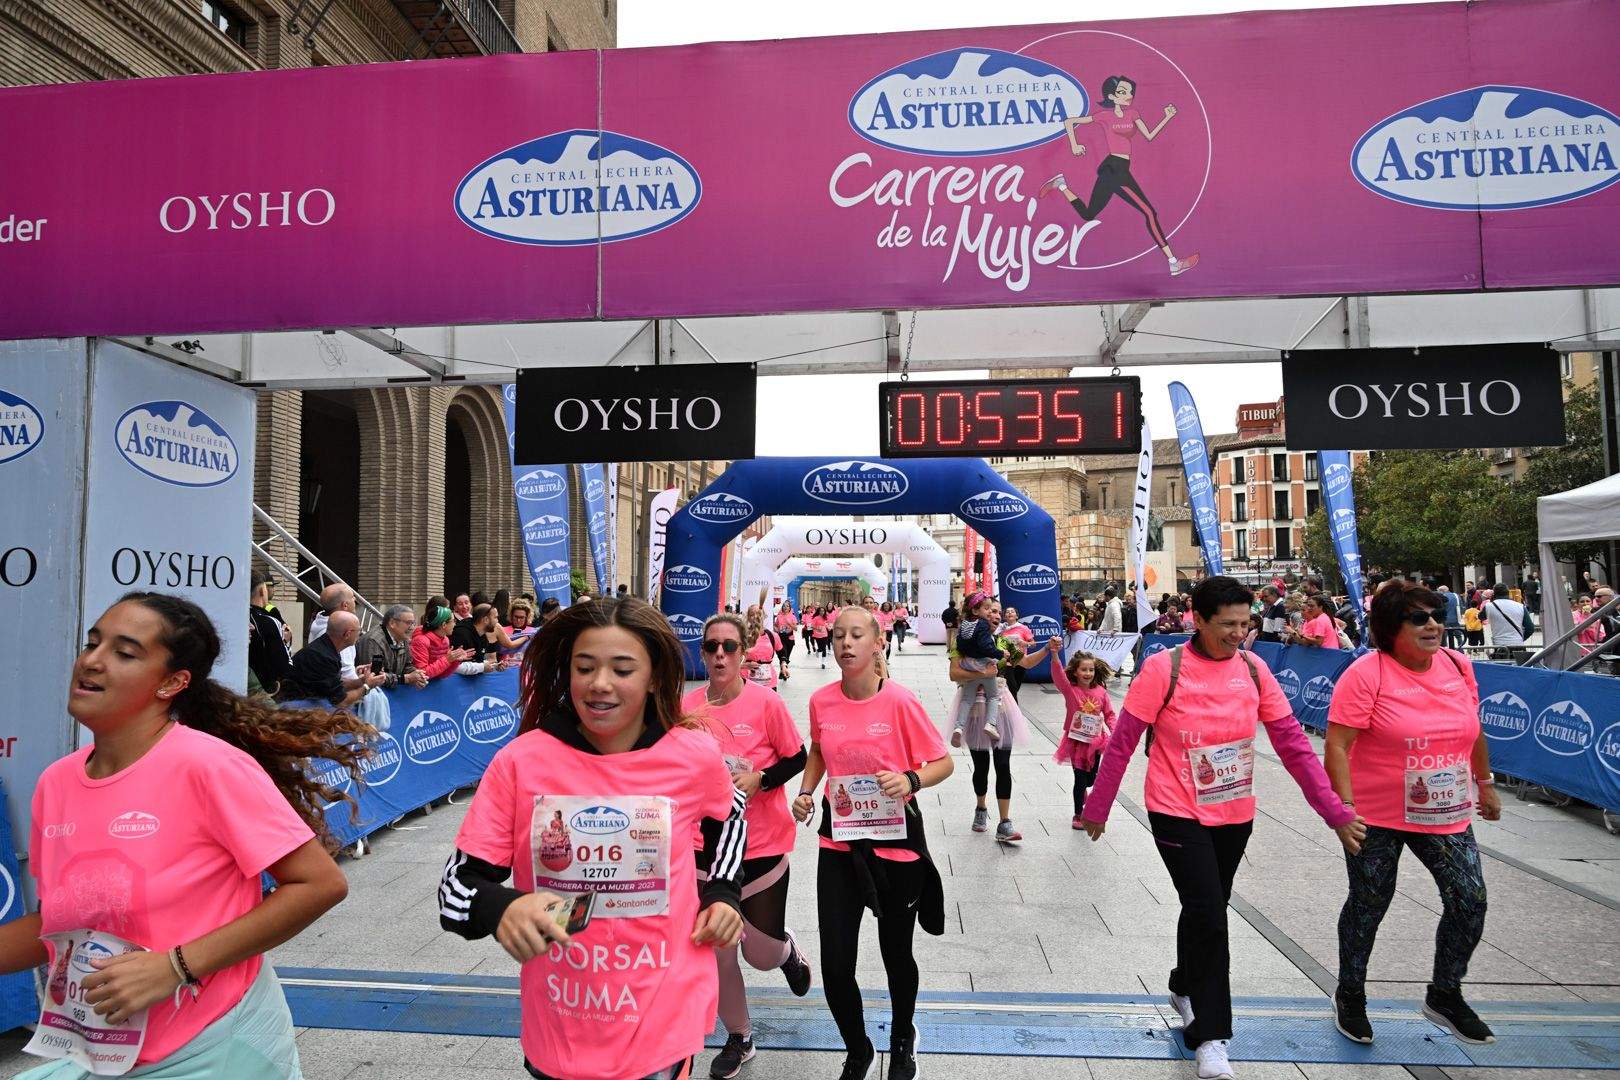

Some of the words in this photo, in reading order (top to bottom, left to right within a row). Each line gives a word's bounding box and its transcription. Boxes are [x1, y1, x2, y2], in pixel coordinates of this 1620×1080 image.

[904, 85, 977, 98] CENTRAL
[985, 82, 1062, 96] LECHERA
[867, 91, 1068, 131] ASTURIANA
[1416, 128, 1504, 144] CENTRAL
[1514, 123, 1607, 139] LECHERA
[1374, 136, 1618, 182] ASTURIANA
[511, 169, 586, 184] CENTRAL
[595, 165, 674, 179] LECHERA
[829, 153, 1026, 208] Carrera
[473, 176, 683, 219] ASTURIANA
[159, 188, 336, 233] OYSHO
[877, 210, 914, 248] de
[922, 209, 948, 248] la
[943, 197, 1102, 292] Mujer
[1328, 379, 1521, 419] OYSHO
[554, 396, 721, 432] OYSHO
[1241, 409, 1276, 421] TIBUR
[146, 422, 187, 440] CENTRAL
[191, 434, 230, 449] LECHERA
[125, 421, 231, 473] ASTURIANA
[811, 474, 901, 494] ASTURIANA
[1248, 460, 1256, 502] HOTEL
[693, 503, 748, 516] ASTURIANA
[966, 503, 1025, 515] ASTURIANA
[805, 528, 887, 545] OYSHO
[111, 547, 235, 590] OYSHO
[1010, 575, 1056, 587] ASTURIANA
[1084, 634, 1124, 652] OYSHO
[468, 713, 513, 736] ASTURIANA
[1479, 705, 1525, 731] ASTURIANA
[408, 729, 457, 757] ASTURIANA
[1180, 730, 1201, 745] TU
[1405, 737, 1429, 750] TU
[1406, 752, 1468, 769] DORSAL
[1217, 764, 1237, 777] 016
[1431, 790, 1453, 800] 016
[855, 800, 878, 810] 016
[575, 817, 626, 828] ASTURIANA
[577, 845, 623, 861] 016
[582, 867, 617, 878] 12707
[549, 881, 582, 890] CARRERA
[584, 882, 595, 890] DE
[597, 882, 607, 890] LA
[608, 881, 635, 890] MUJER
[638, 881, 656, 890] 2023
[616, 898, 658, 909] Santander
[547, 974, 638, 1012] SUMA
[41, 1034, 73, 1050] OYSHO
